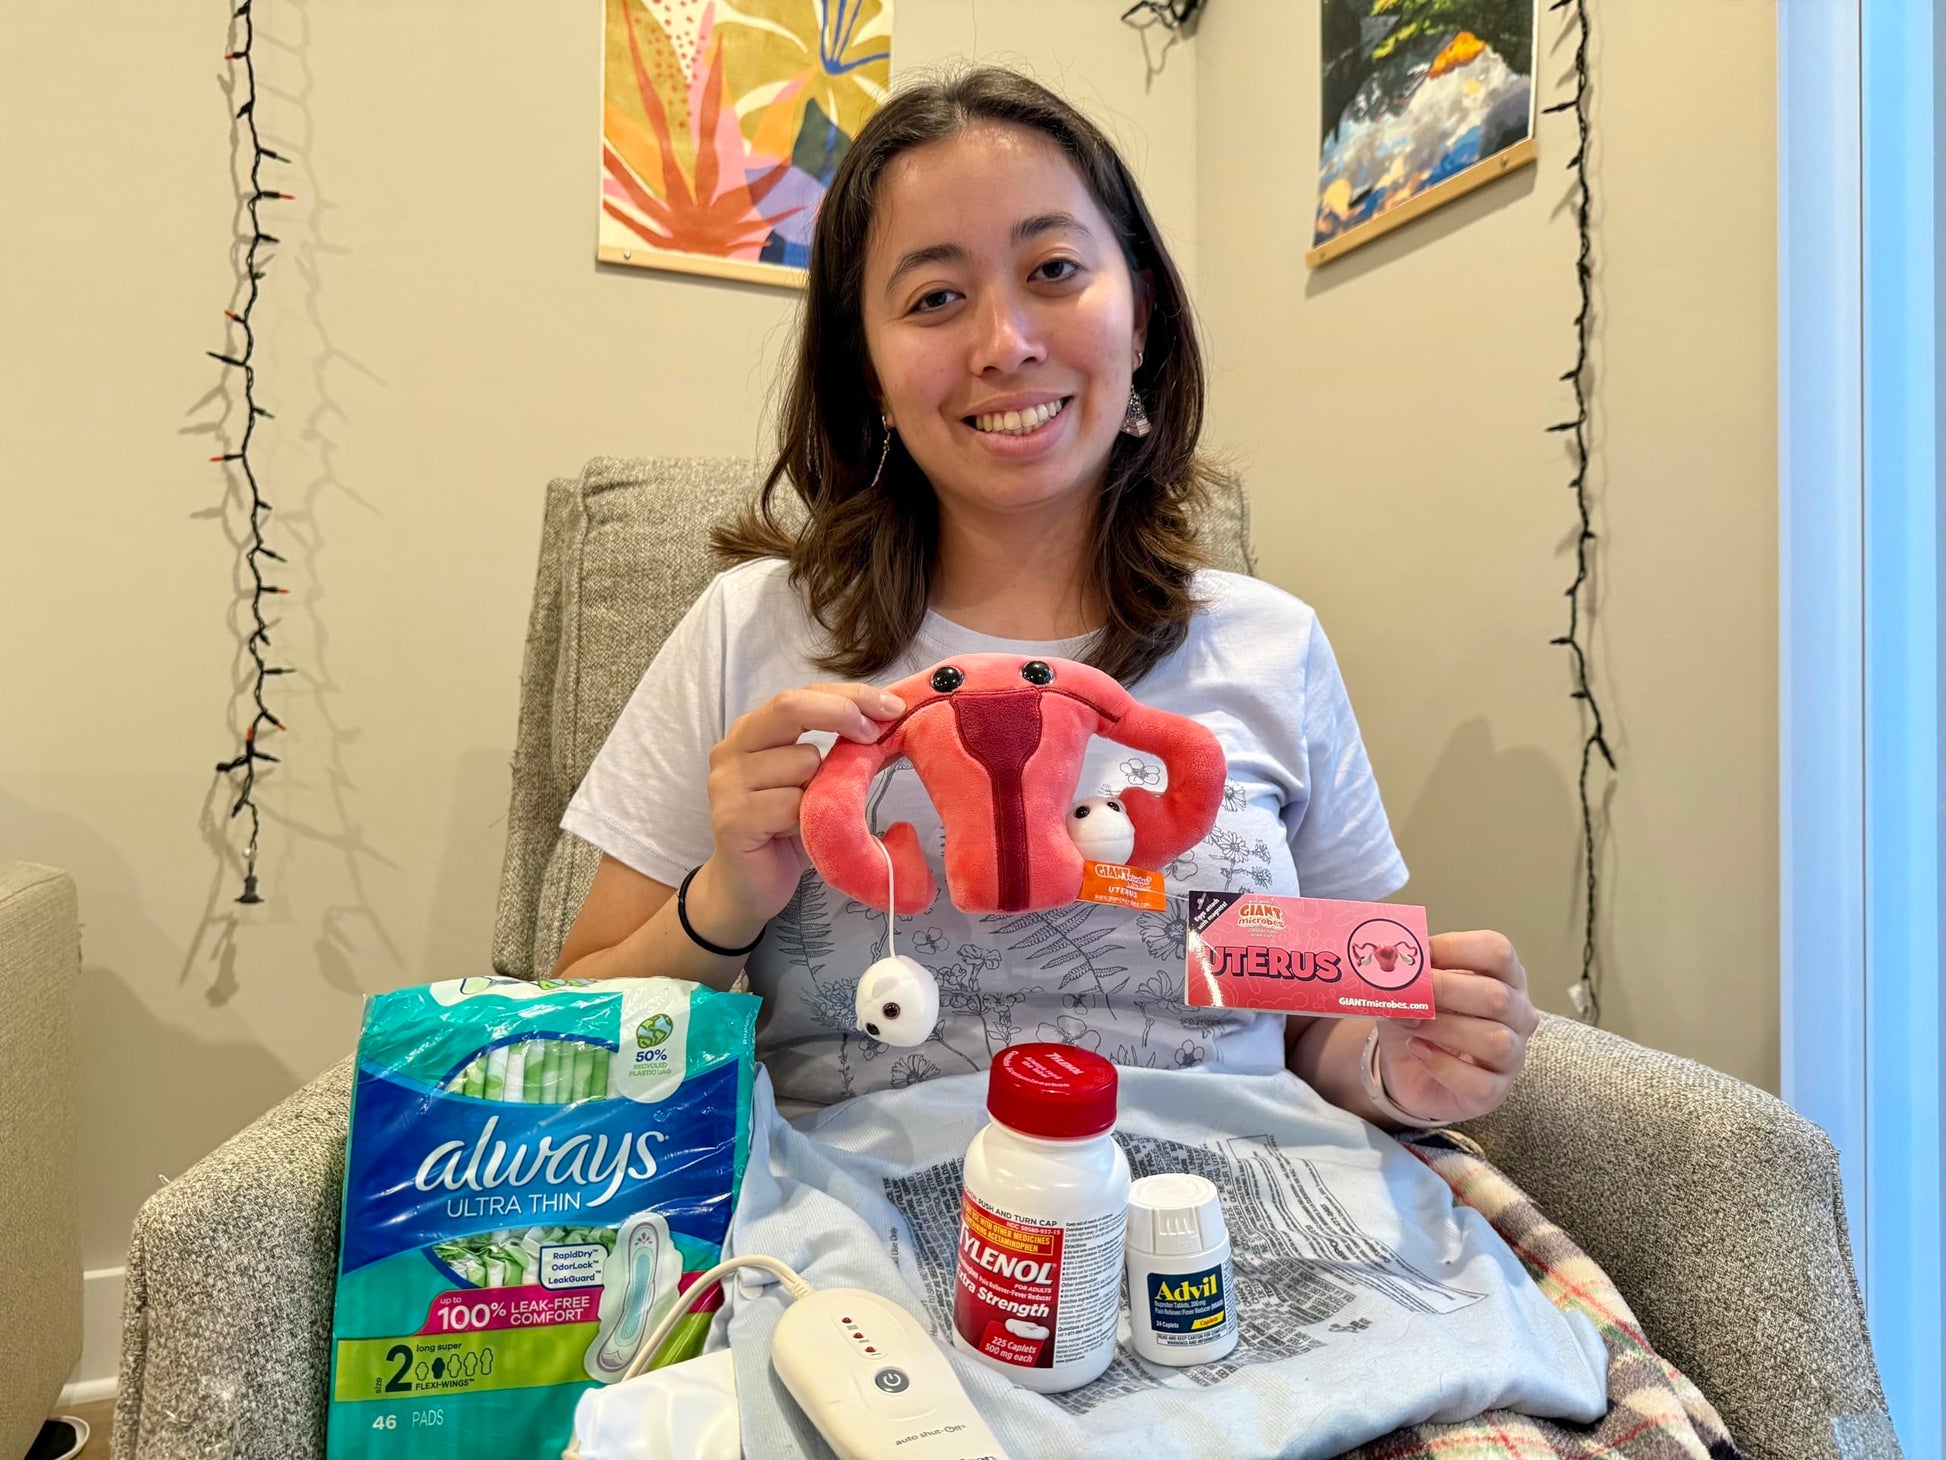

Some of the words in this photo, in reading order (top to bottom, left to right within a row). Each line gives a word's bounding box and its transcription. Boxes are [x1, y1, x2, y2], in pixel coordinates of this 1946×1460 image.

[1096, 865, 1130, 880] GIANT
[1108, 886, 1138, 898] UTERUS
[1194, 910, 1206, 922] Eggs
[1206, 899, 1220, 912] attach
[1198, 920, 1208, 929] with
[1208, 901, 1228, 920] magnets!
[1240, 904, 1282, 919] GIANT
[1203, 946, 1342, 983] UTERUS
[1338, 997, 1429, 1010] GIANTmicrobes.com
[636, 1048, 667, 1062] 50%
[415, 1115, 666, 1206] always
[447, 1195, 522, 1218] ULTRA
[528, 1192, 581, 1214] THIN
[978, 1199, 994, 1212] PUSH
[996, 1208, 1012, 1219] AND
[1015, 1214, 1037, 1225] TURN
[988, 1231, 1038, 1252] ACETAMINOPHEN
[993, 1225, 1012, 1237] OTHER
[1014, 1231, 1050, 1245] MEDICINES
[960, 1222, 1053, 1285] TYLENOL
[1028, 1293, 1052, 1301] Reducer
[1154, 1274, 1218, 1301] Advil
[440, 1297, 451, 1305] up
[453, 1296, 462, 1304] to
[977, 1287, 1049, 1317] Strength
[437, 1302, 507, 1330] 100%
[511, 1296, 590, 1313] LEAK-FREE
[510, 1309, 584, 1325] COMFORT
[1200, 1317, 1218, 1325] Caplets
[416, 1344, 435, 1353] long
[437, 1342, 462, 1351] super
[985, 1343, 1000, 1354] 500
[1000, 1350, 1012, 1360] mg
[992, 1336, 1007, 1347] 225
[1008, 1342, 1036, 1354] Caplets
[385, 1344, 414, 1393] 2
[372, 1415, 397, 1430] 46
[412, 1409, 444, 1427] PADS
[896, 1435, 919, 1446] auto
